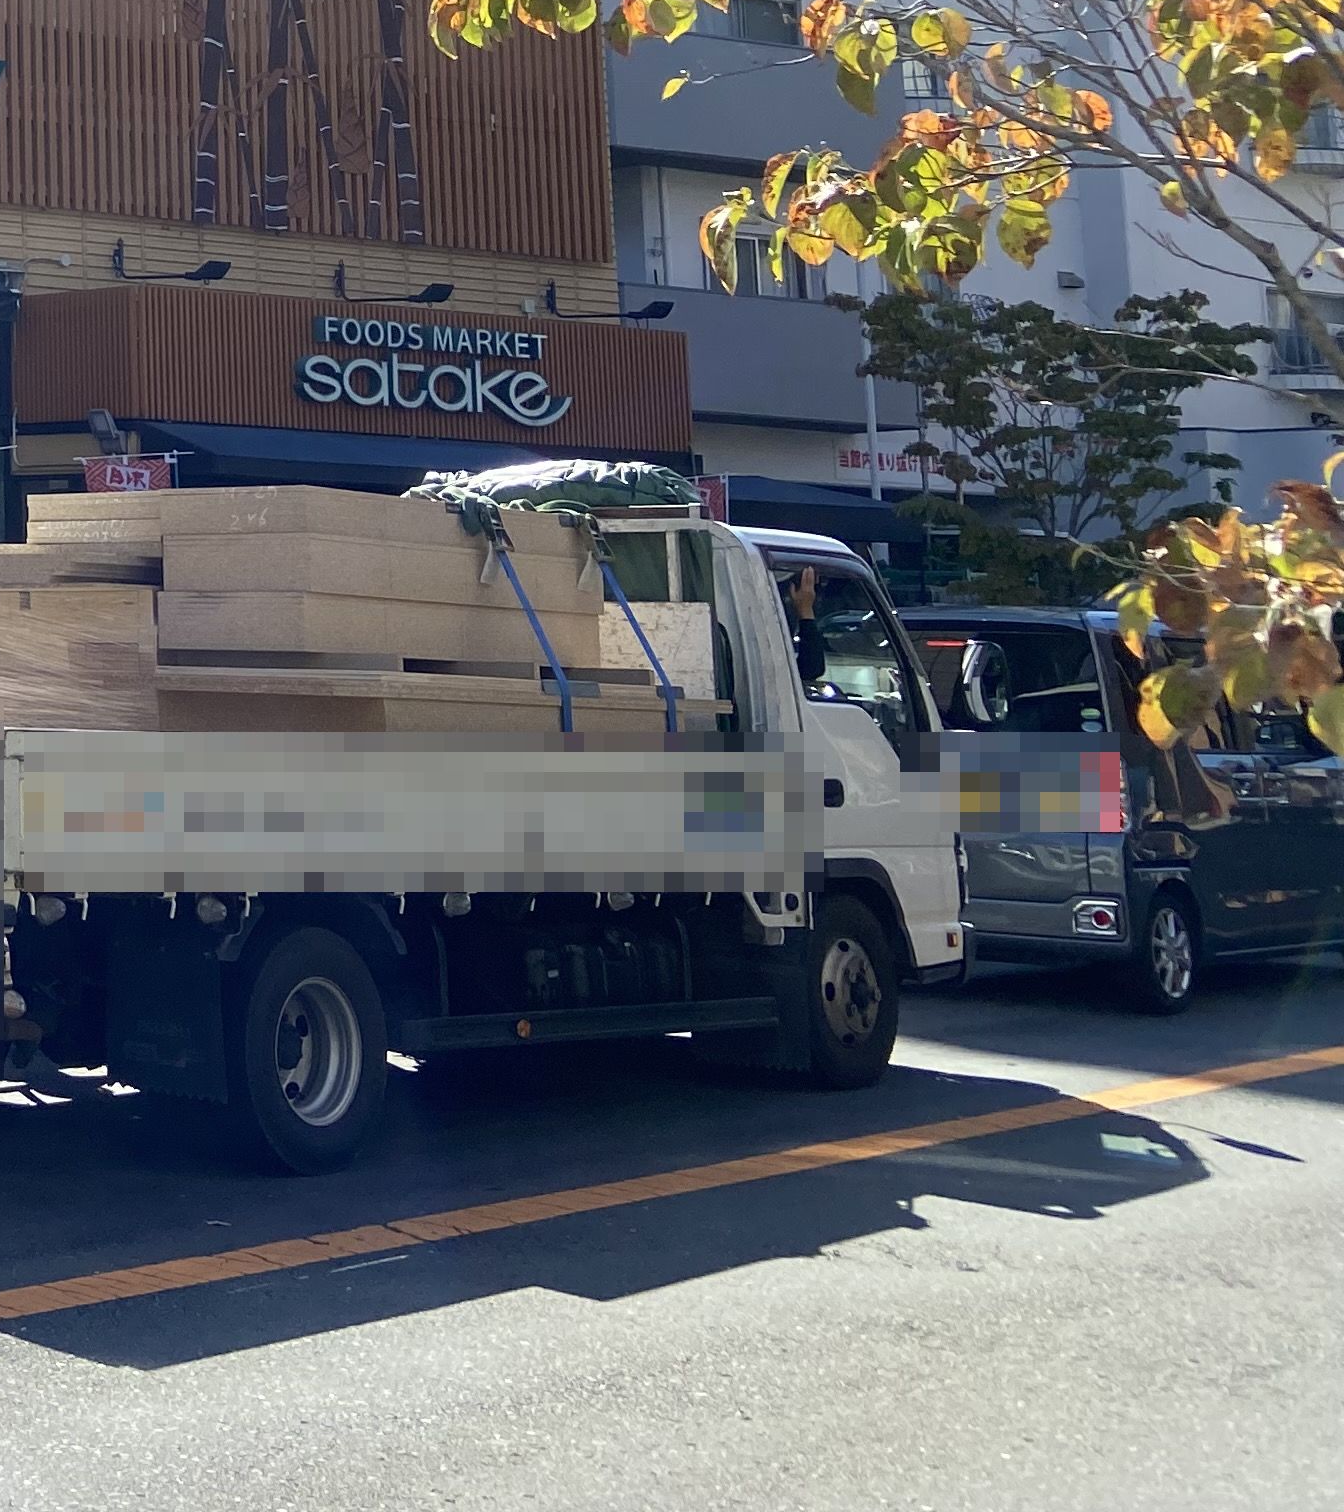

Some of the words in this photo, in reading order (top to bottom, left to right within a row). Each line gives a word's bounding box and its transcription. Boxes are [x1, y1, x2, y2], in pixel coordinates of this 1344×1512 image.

[323, 316, 424, 350] FOODS
[433, 325, 548, 360] MARKET
[303, 353, 572, 427] satake
